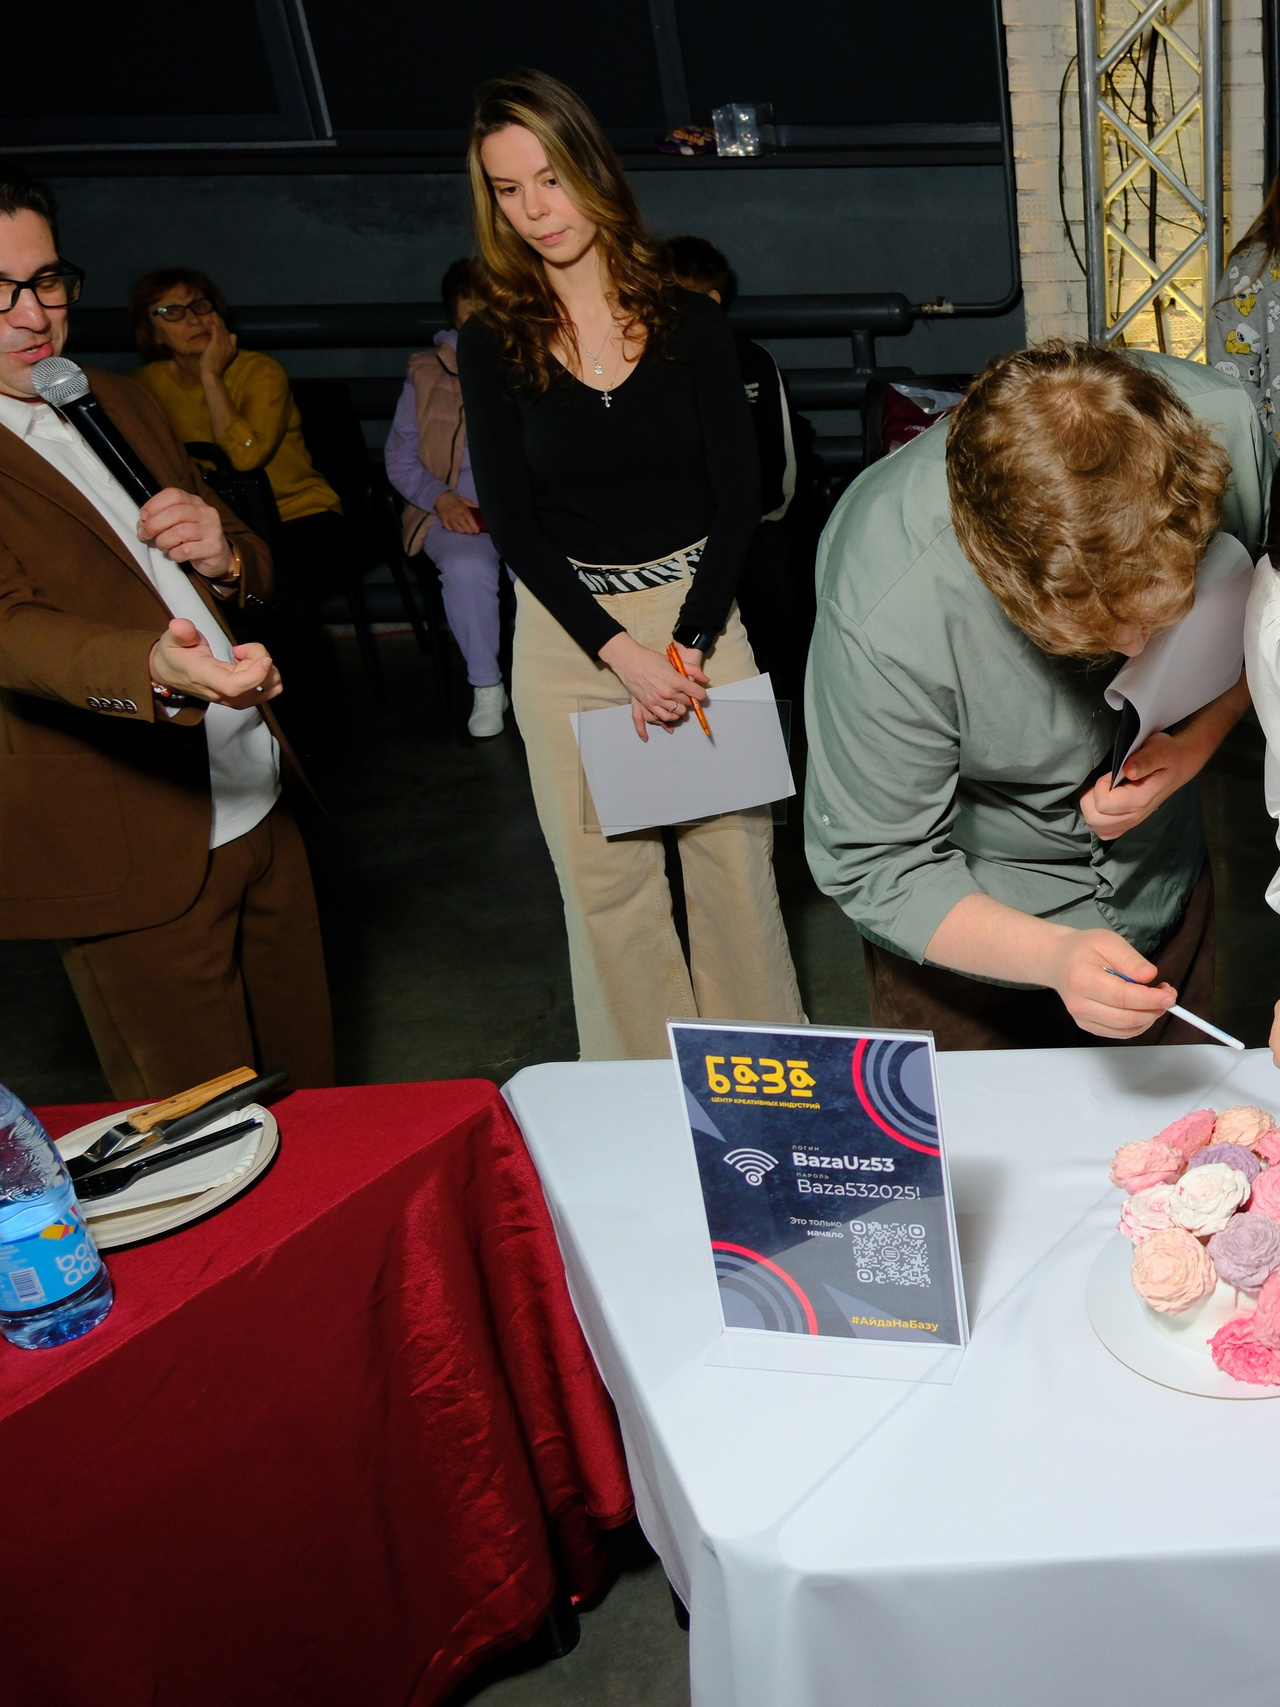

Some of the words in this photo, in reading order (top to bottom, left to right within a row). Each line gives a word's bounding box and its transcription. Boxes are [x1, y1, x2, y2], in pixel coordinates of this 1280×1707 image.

[711, 1096, 733, 1104] ЦЕНТР
[733, 1098, 779, 1107] КРЕАТИВНЫХ
[779, 1101, 821, 1110] ИНДУСТРИЙ
[792, 1151, 895, 1172] BazaUz53
[796, 1172, 830, 1180] ПАРОЛЬ
[797, 1179, 921, 1200] Baza532025!
[789, 1216, 807, 1225] Это
[808, 1218, 842, 1228] только
[807, 1230, 844, 1238] начало
[851, 1315, 939, 1332] #АйдаНаБазу
